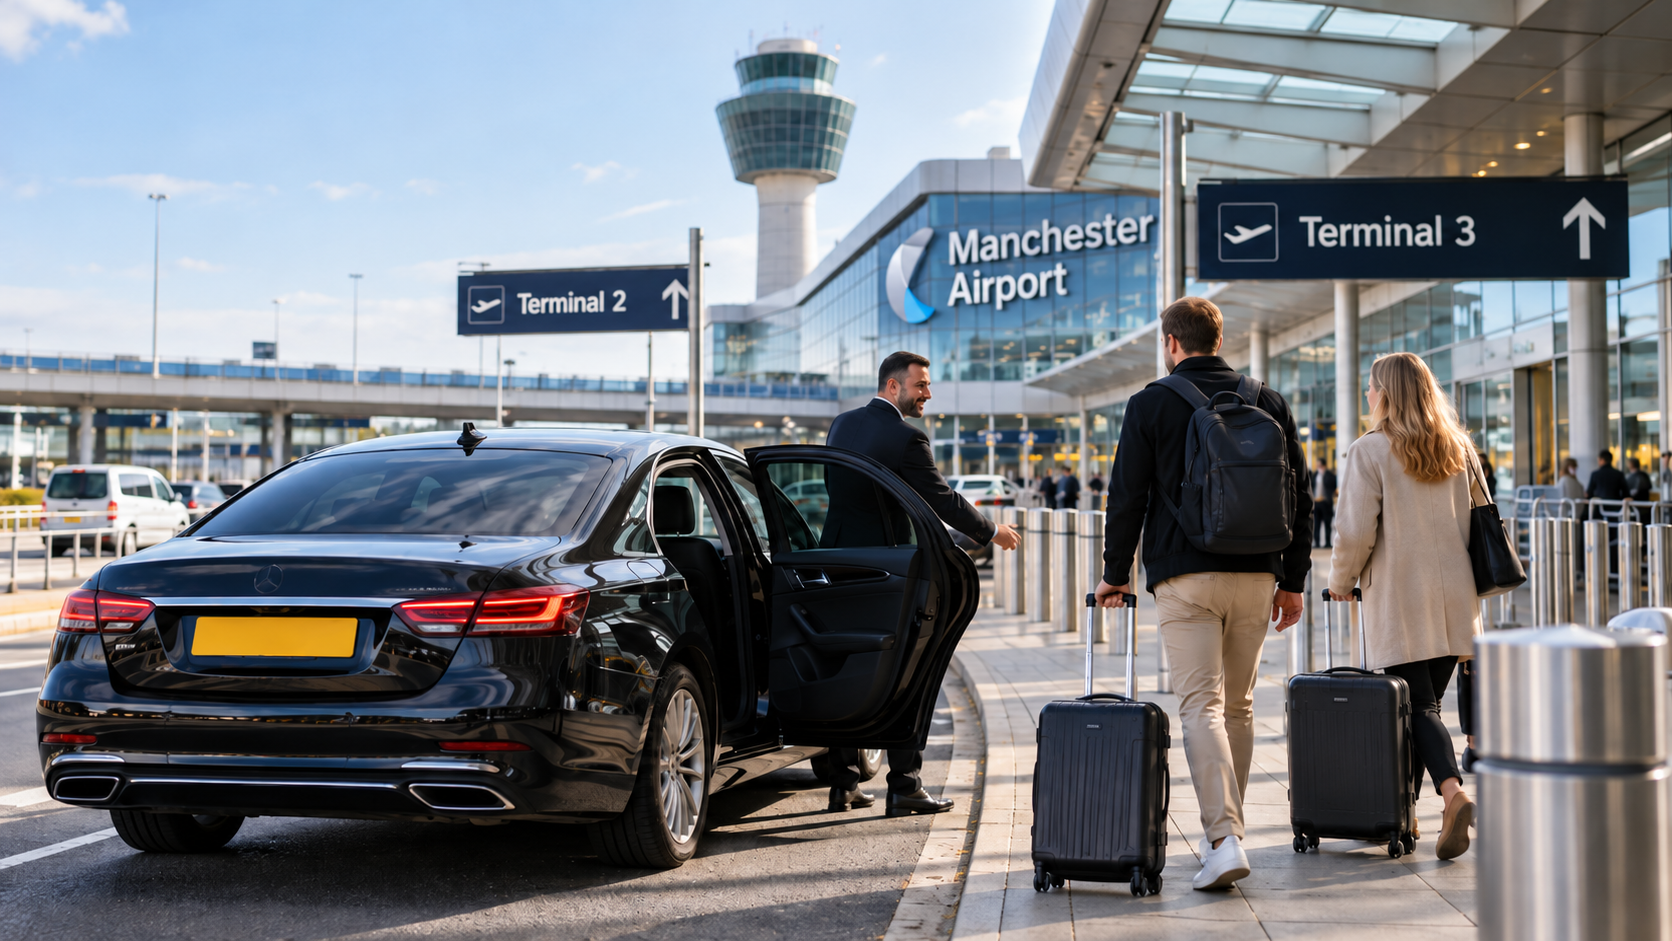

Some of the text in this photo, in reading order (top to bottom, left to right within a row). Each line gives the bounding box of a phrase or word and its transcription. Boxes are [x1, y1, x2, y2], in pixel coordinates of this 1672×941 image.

[949, 213, 1154, 266] Manchester
[1299, 214, 1476, 247] Terminal 3
[516, 289, 627, 315] Terminal 2
[947, 262, 1068, 311] Airport
